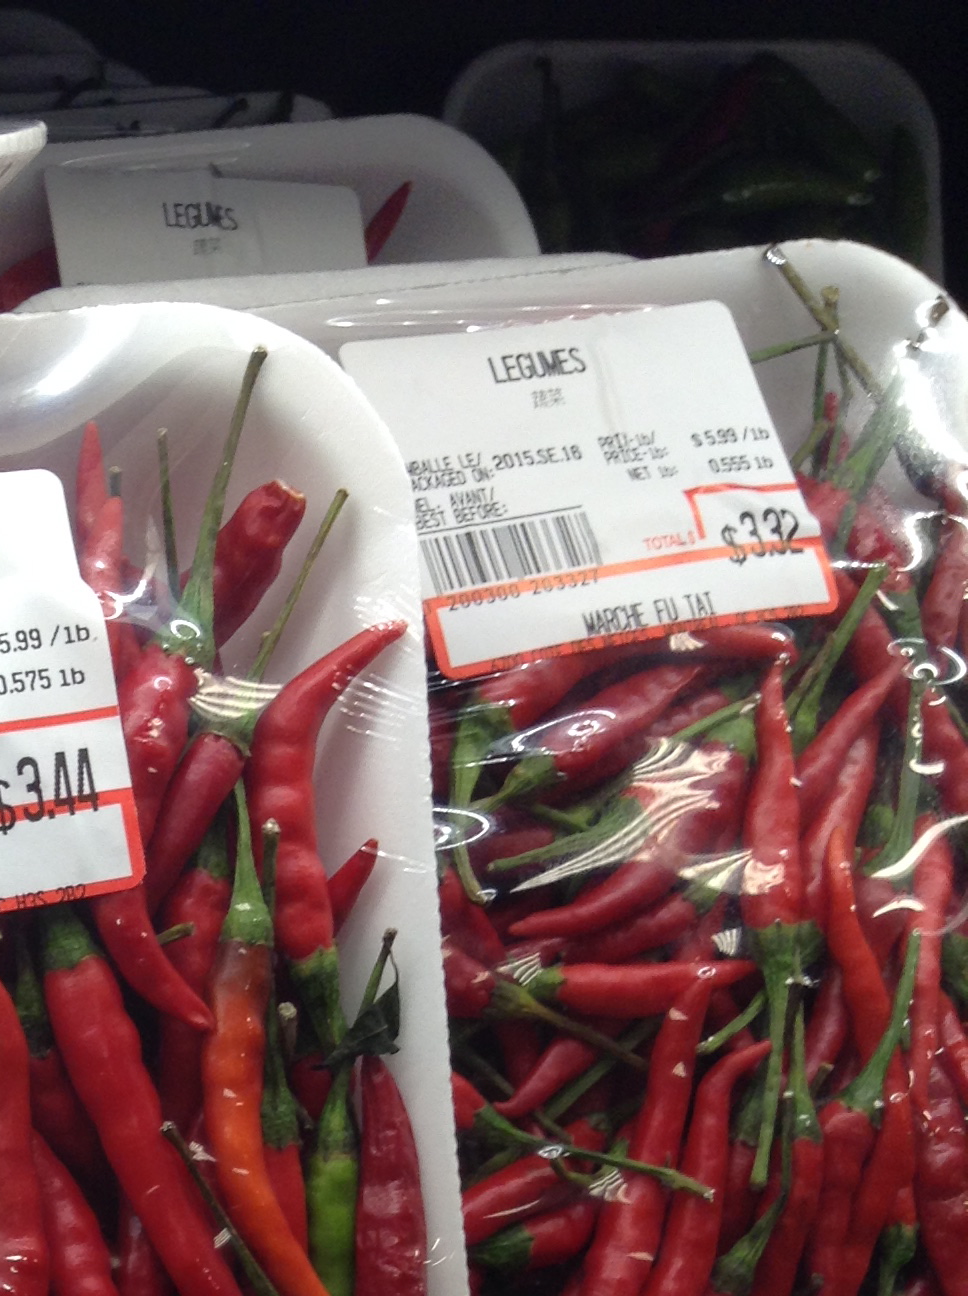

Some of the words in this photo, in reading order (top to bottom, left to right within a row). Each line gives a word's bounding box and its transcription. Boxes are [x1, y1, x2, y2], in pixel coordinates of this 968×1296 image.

[487, 347, 586, 384] LEGUMES
[406, 455, 454, 477] MBALLE
[411, 470, 466, 492] ACKAGED
[643, 533, 686, 551] TOTAL
[582, 602, 649, 636] MARCHE
[654, 598, 679, 623] FU
[684, 591, 717, 617] TAI
